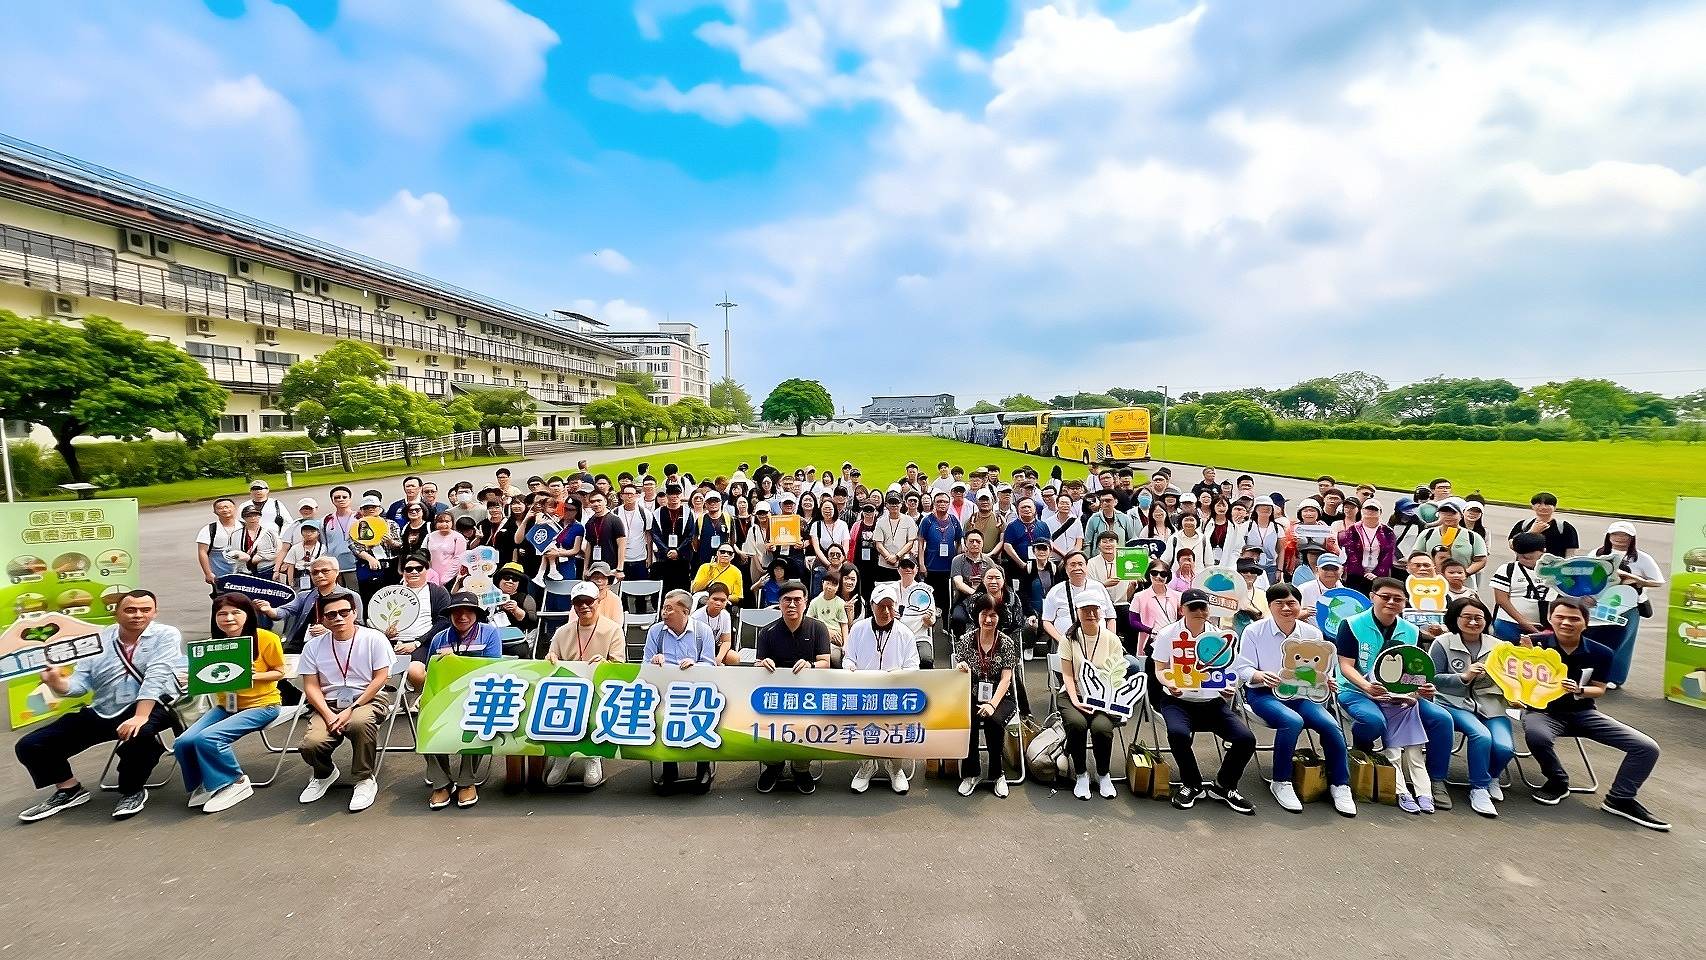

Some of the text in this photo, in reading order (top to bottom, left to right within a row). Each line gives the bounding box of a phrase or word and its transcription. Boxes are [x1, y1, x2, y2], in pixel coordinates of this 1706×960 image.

[223, 582, 293, 600] Sustainability
[379, 588, 397, 600] Love
[399, 589, 417, 607] Earth
[1211, 671, 1223, 683] G
[1506, 657, 1550, 683] ESG
[463, 675, 721, 744] 華固建設
[750, 722, 927, 745] 115.Q2季會活動
